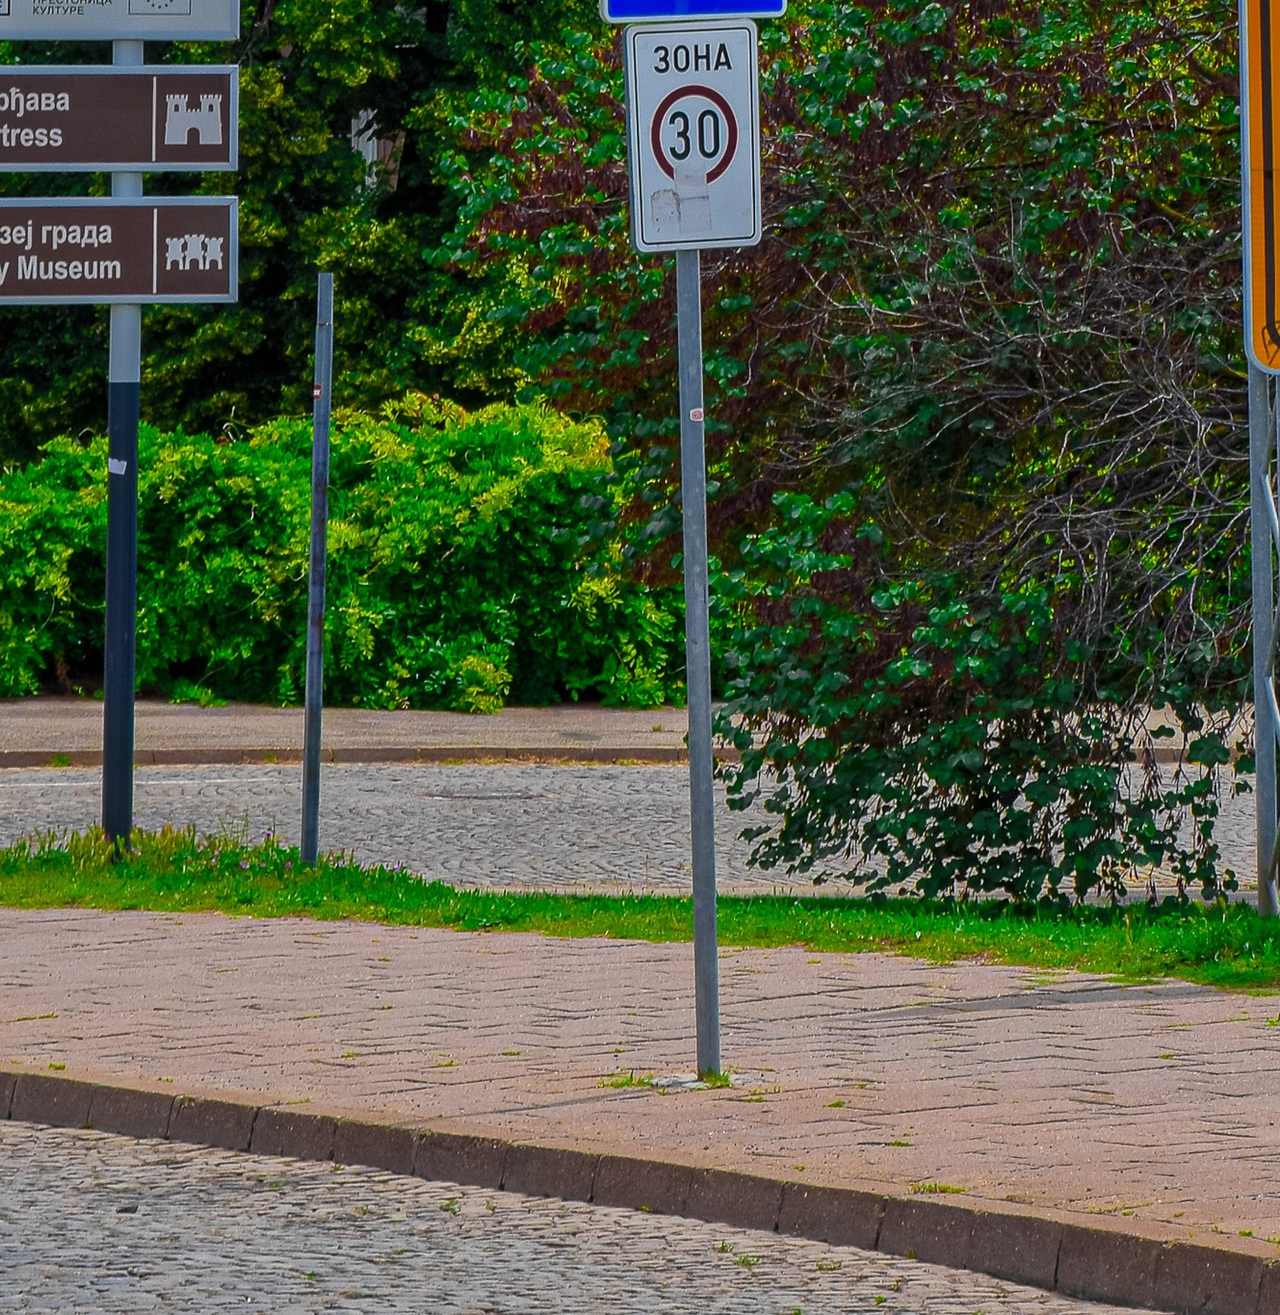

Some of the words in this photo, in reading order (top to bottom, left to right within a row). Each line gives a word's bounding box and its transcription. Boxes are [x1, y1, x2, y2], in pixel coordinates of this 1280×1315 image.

[32, 5, 85, 17] КУЛТУРЕ
[653, 43, 733, 75] ЗОНА
[0, 122, 63, 147] tress
[668, 108, 720, 161] 30
[41, 224, 113, 250] града
[17, 255, 121, 281] Museum
